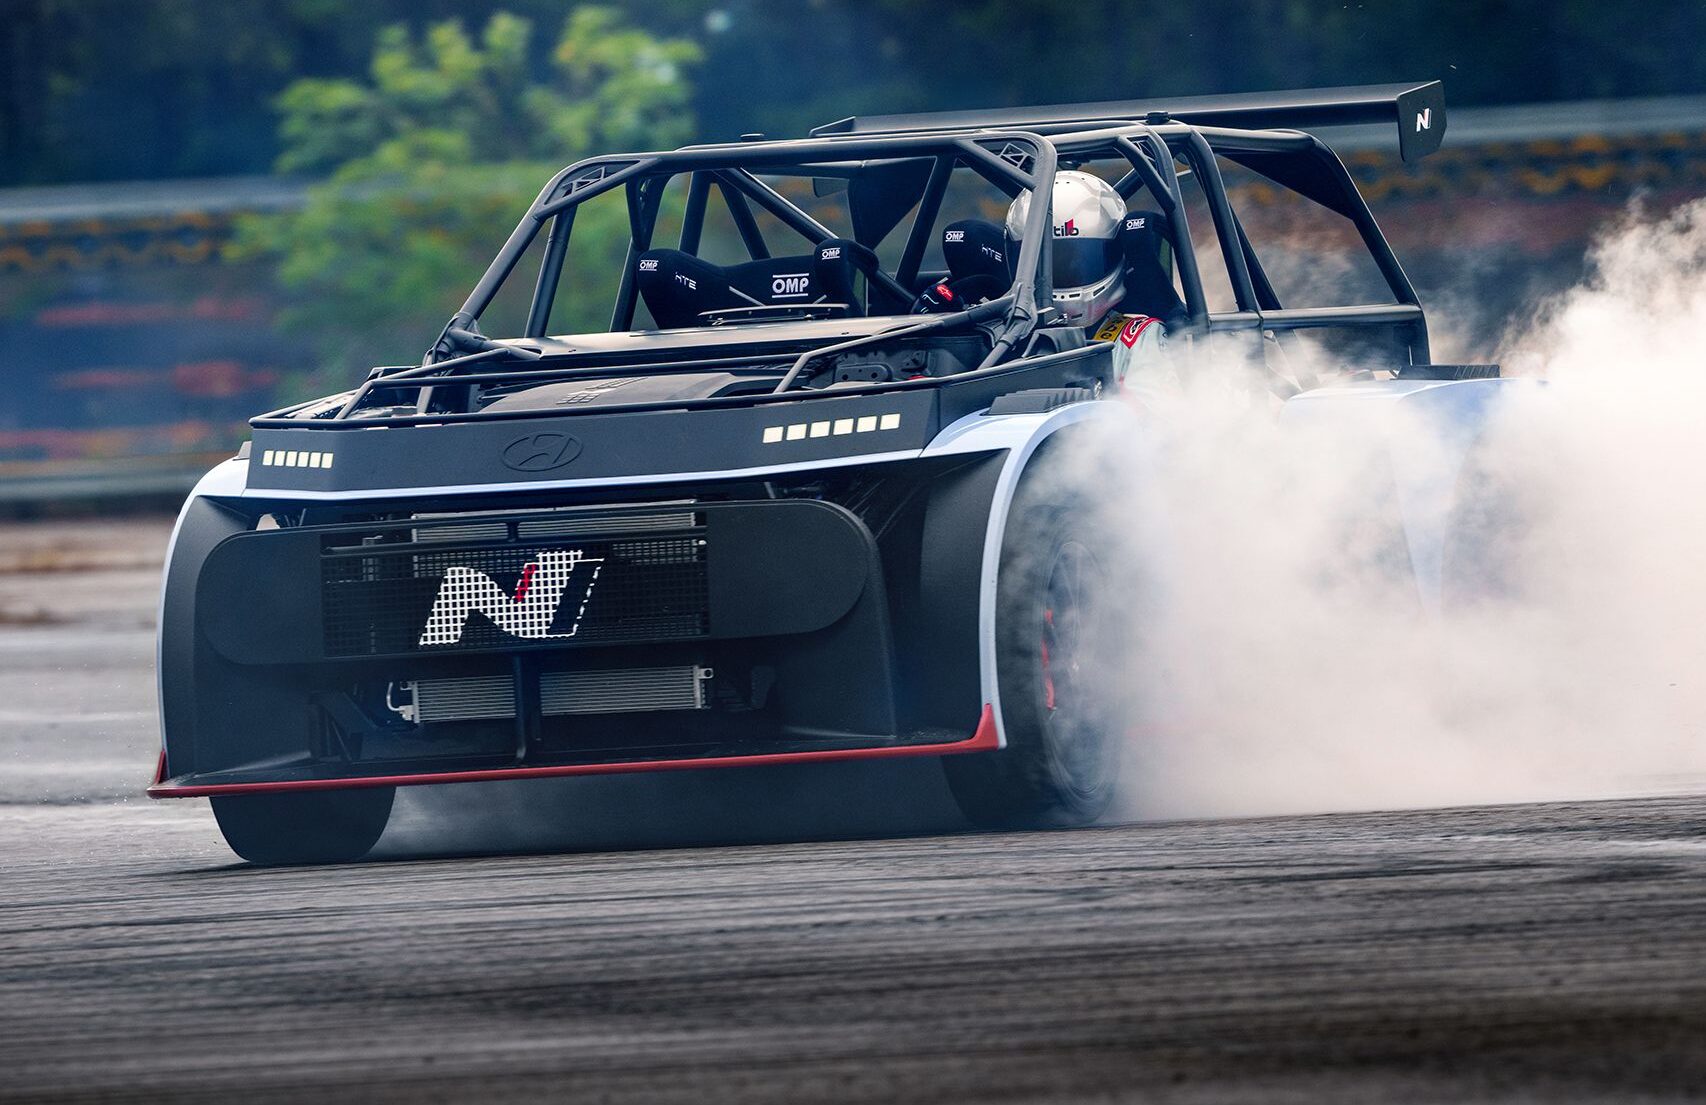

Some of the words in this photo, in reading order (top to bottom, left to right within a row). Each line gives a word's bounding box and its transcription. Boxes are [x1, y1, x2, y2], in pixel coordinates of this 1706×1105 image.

[1051, 218, 1080, 237] tilo
[1126, 219, 1145, 230] OMP
[945, 231, 964, 242] OMP
[822, 249, 840, 259] OMP
[640, 260, 658, 270] OMP
[772, 275, 809, 296] OMP
